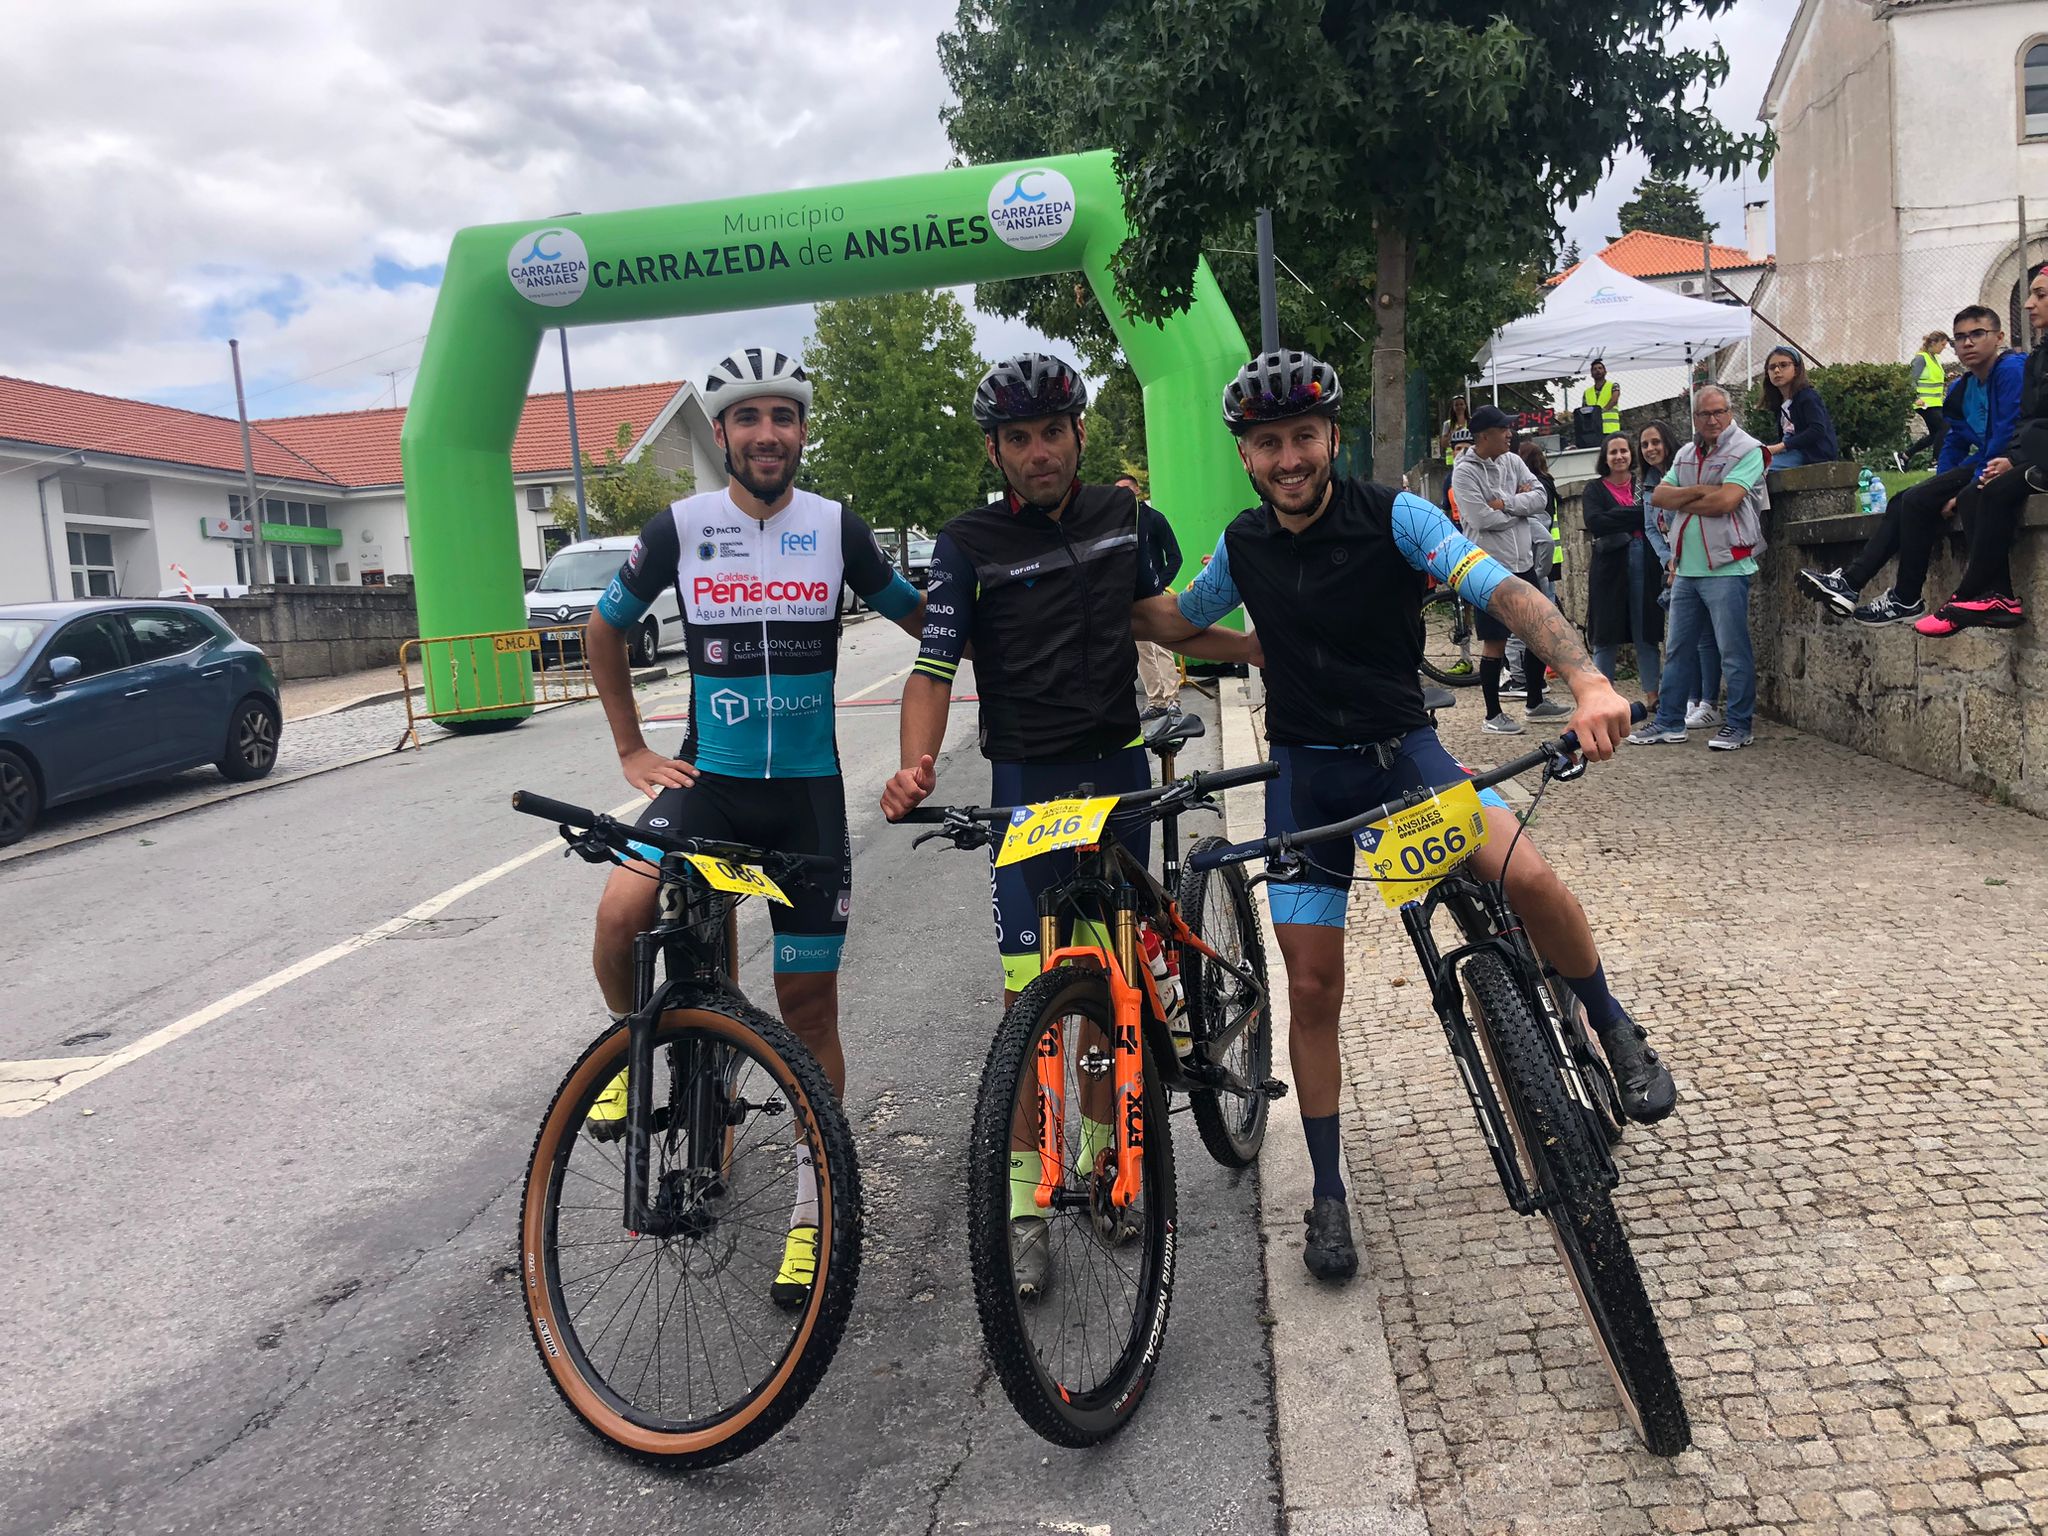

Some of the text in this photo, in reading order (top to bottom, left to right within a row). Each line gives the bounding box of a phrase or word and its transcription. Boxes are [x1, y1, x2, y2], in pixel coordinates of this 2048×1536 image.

[723, 203, 845, 235] Município
[991, 201, 1072, 221] CARRAZEDA
[592, 213, 990, 289] CARRAZEDA de ANSIÃES
[511, 260, 587, 279] CARRAZEDA
[716, 526, 741, 535] PACTO
[781, 530, 817, 556] feel
[716, 571, 750, 583] Caldas
[693, 577, 829, 605] Penacova
[730, 604, 782, 617] Mineral
[787, 604, 828, 616] Natural
[758, 639, 822, 652] GONÇALVES
[753, 694, 822, 712] TOUCH
[1027, 815, 1083, 846] 046
[1400, 826, 1467, 876] 066
[797, 948, 829, 957] TOUCH
[1126, 1091, 1144, 1149] FOX
[1142, 1289, 1169, 1365] MEZCAL
